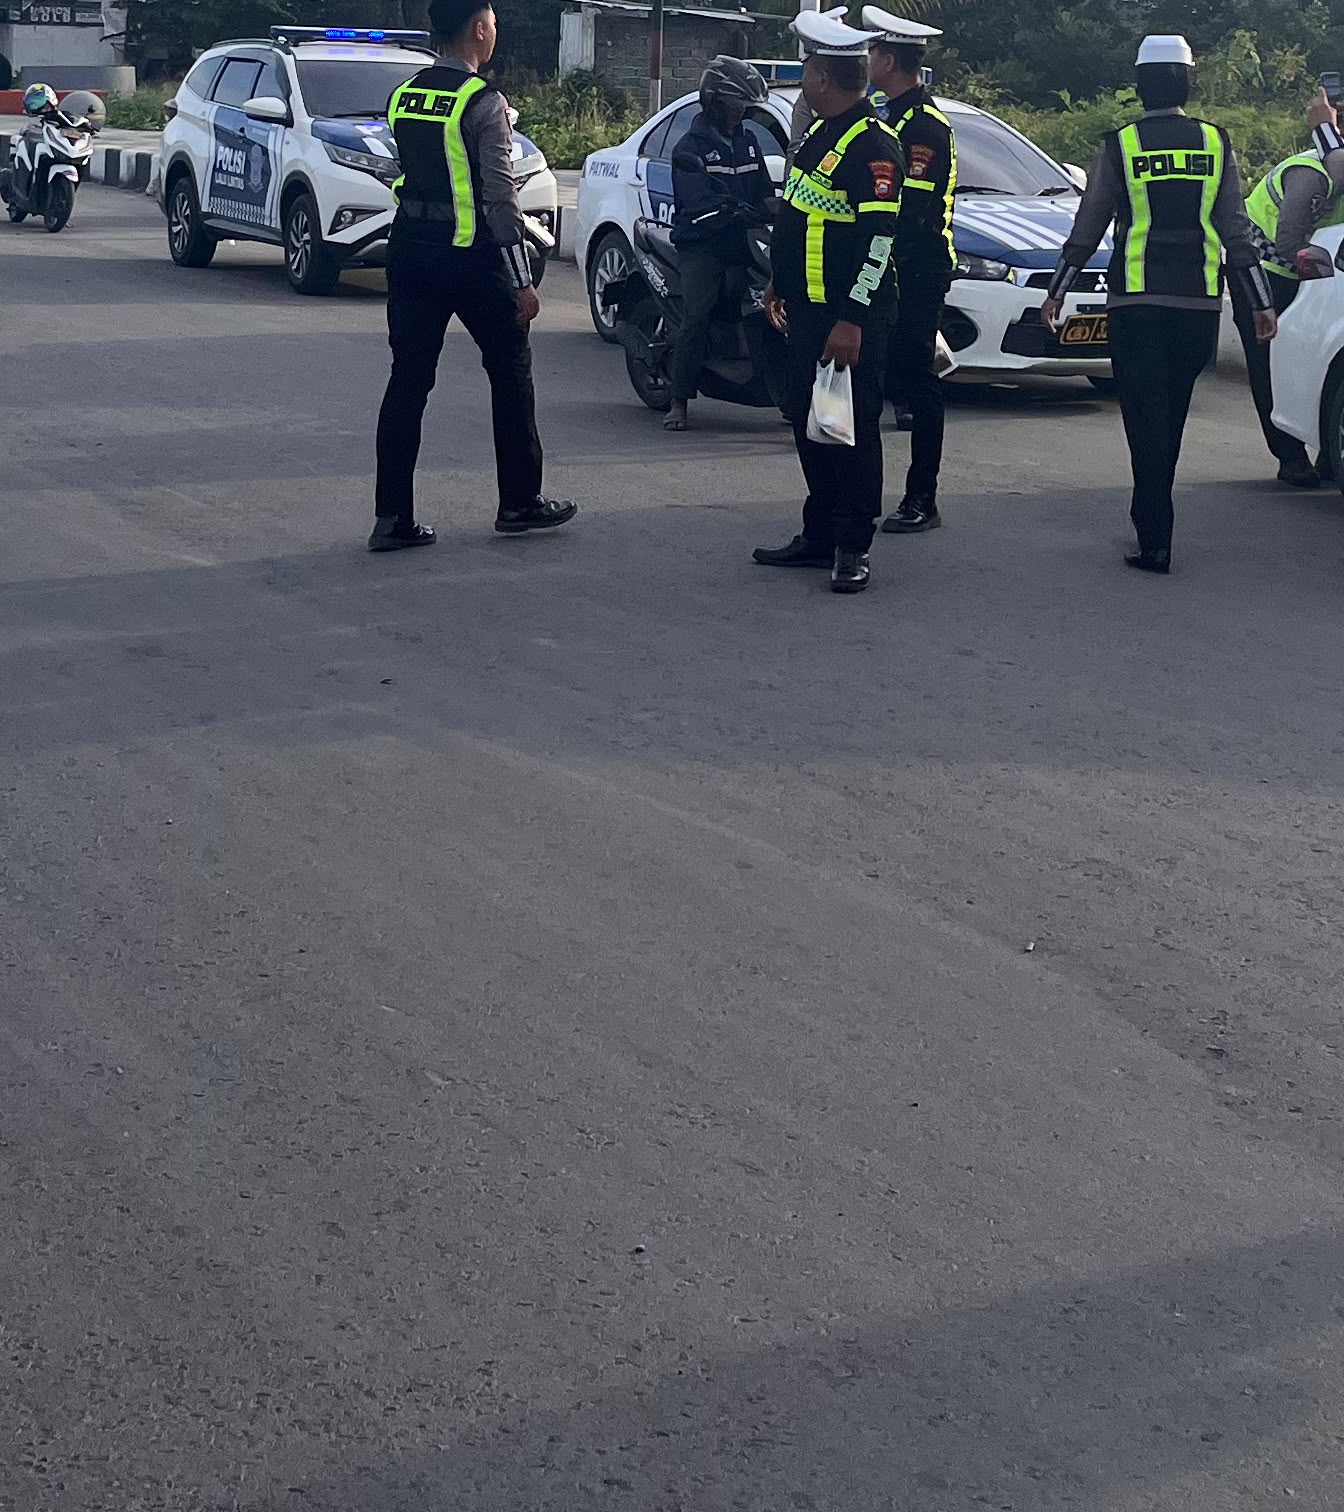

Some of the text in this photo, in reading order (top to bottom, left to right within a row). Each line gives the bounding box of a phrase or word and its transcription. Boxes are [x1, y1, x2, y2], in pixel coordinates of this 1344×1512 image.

[395, 92, 458, 118] POLISI
[216, 145, 247, 175] POLISI
[588, 161, 621, 179] PATWAL
[1132, 154, 1214, 179] POLISI
[848, 235, 895, 306] POLISI
